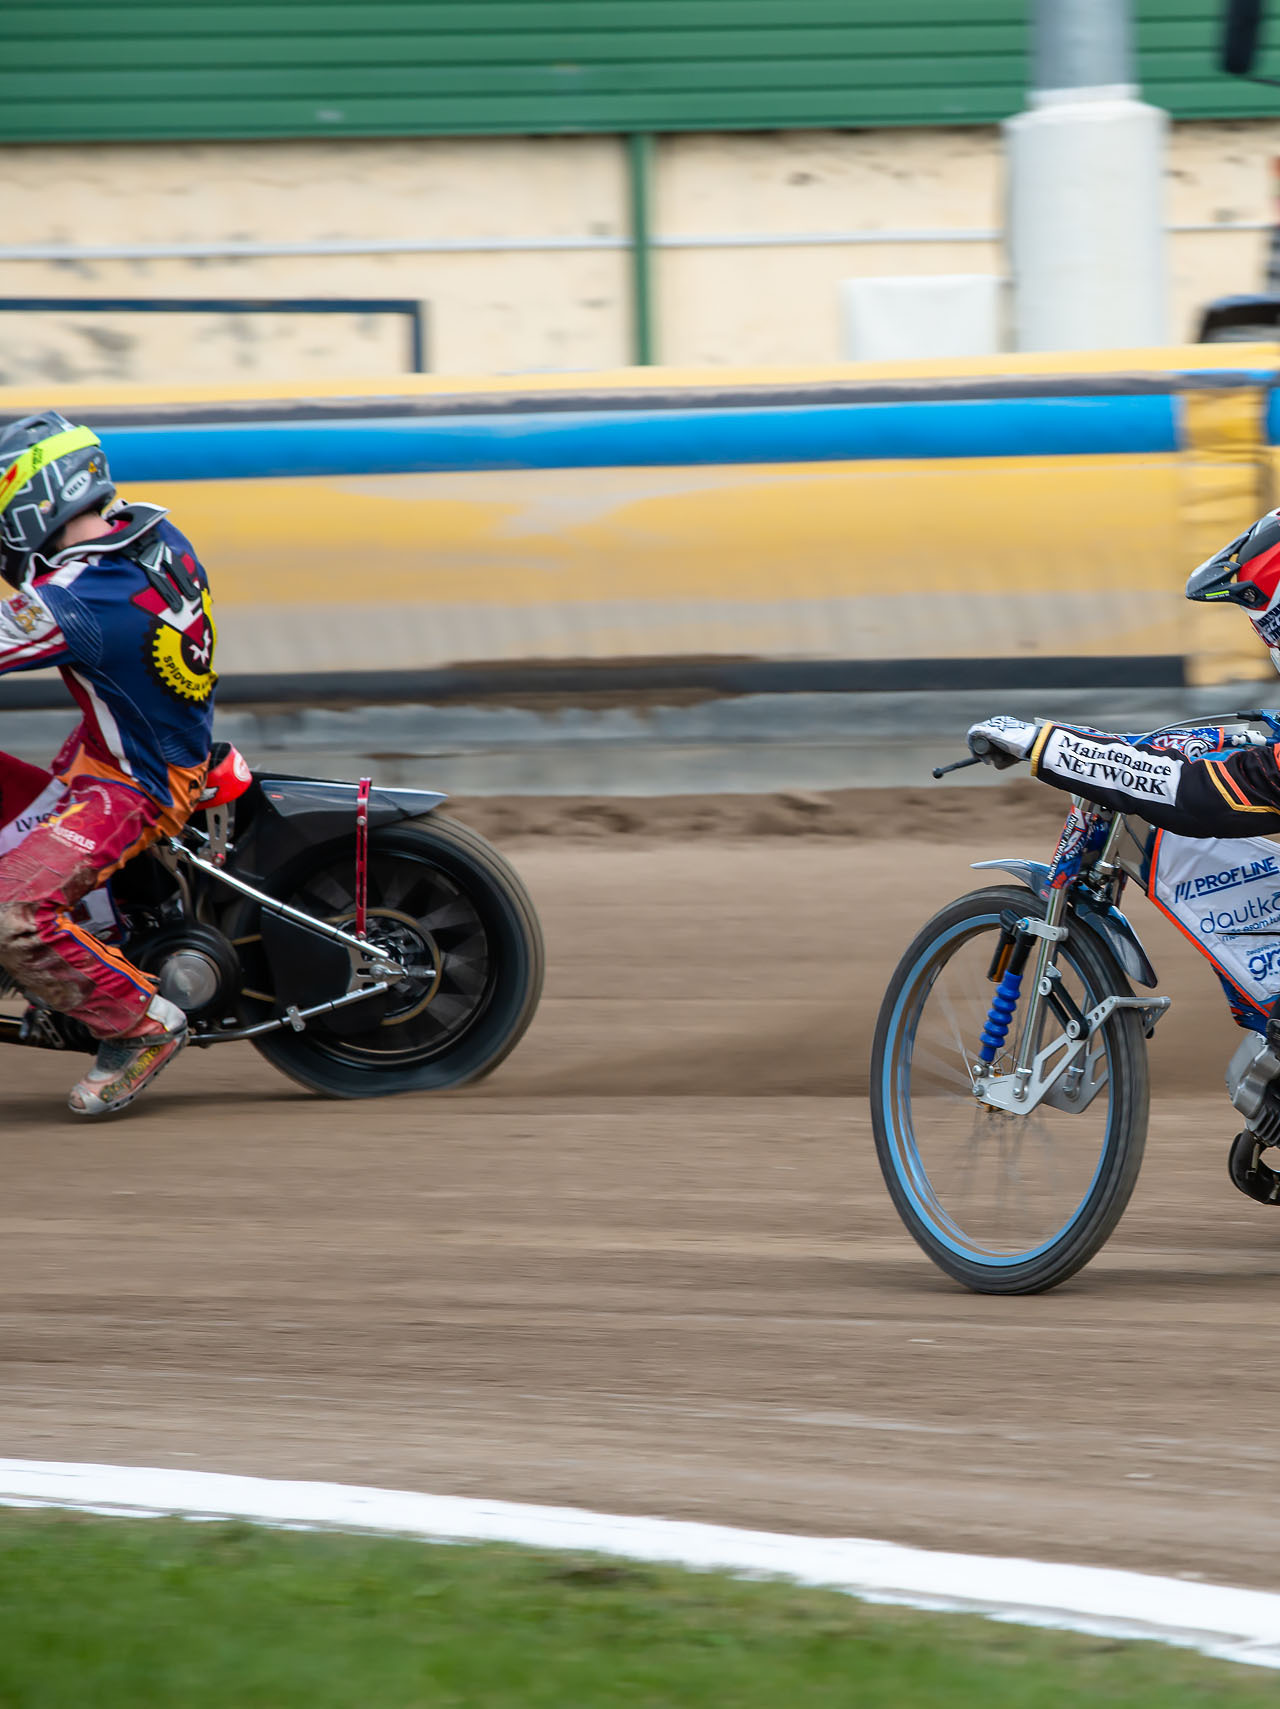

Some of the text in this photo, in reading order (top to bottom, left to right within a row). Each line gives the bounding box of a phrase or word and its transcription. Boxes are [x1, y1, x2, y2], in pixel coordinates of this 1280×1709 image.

[66, 477, 87, 497] BELL
[1055, 751, 1167, 797] NETWORK
[1058, 735, 1172, 776] Maintenance
